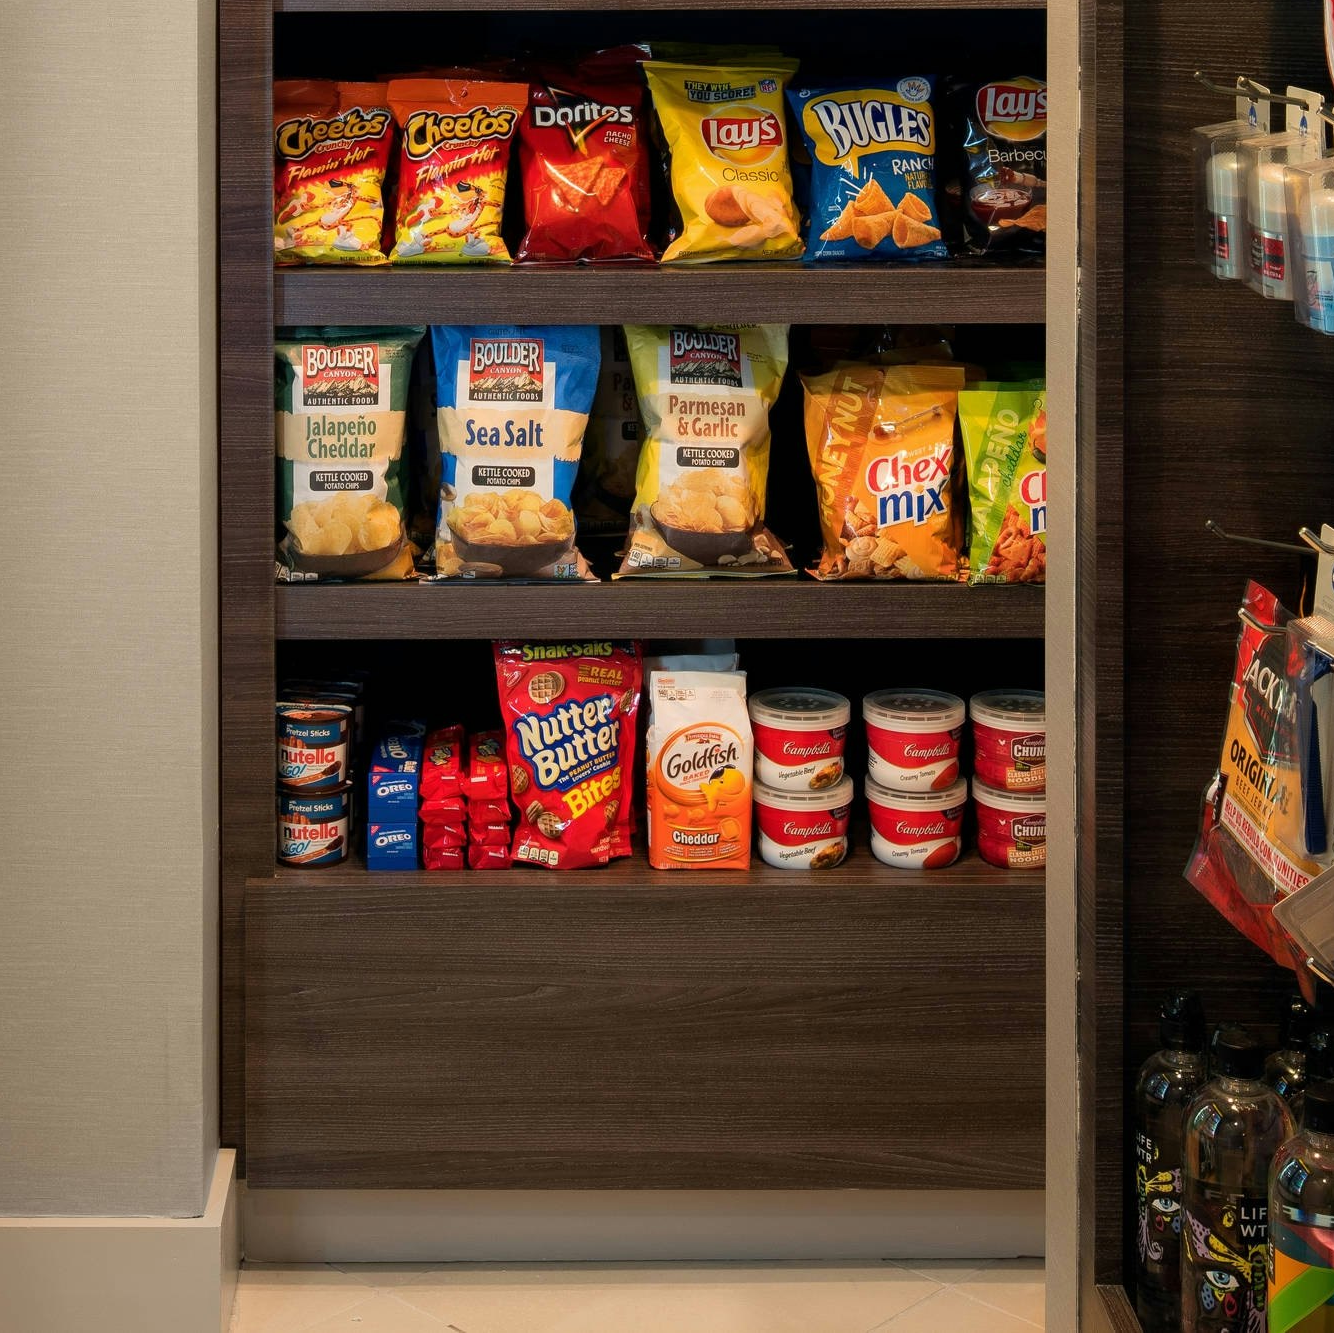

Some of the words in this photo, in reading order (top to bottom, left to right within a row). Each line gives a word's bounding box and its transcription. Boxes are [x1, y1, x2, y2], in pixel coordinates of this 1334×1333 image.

[685, 80, 709, 92] THEY
[689, 88, 711, 101] YOU
[713, 86, 756, 101] SCORE!
[534, 101, 634, 127] Doritos
[278, 109, 387, 156] Cheetos
[406, 109, 513, 156] Cheetos
[605, 129, 633, 141] NACHO
[709, 115, 778, 151] Lay's
[812, 99, 931, 159] BUGLES
[315, 139, 354, 154] Crunchy
[442, 139, 481, 151] Crunchy
[603, 135, 632, 148] CHEESE
[470, 146, 500, 169] Hot
[288, 158, 341, 187] Flamin'
[343, 146, 375, 166] Hot
[722, 167, 779, 182] Classic
[672, 329, 739, 362] BOULDER
[305, 346, 377, 377] BOULDER
[473, 341, 541, 373] BOULDER
[690, 352, 723, 361] CANYON
[323, 370, 358, 379] CANYON
[490, 365, 523, 375] CANYON
[674, 377, 716, 386] AUTHENTIC
[717, 378, 740, 388] FOODS
[307, 396, 350, 406] AUTHENTIC
[351, 397, 376, 406] FOODS
[473, 392, 514, 401] AUTHENTIC
[515, 392, 540, 402] FOODS
[831, 376, 869, 432] NUT
[669, 394, 746, 417] Parmesan
[306, 415, 378, 442] Jalapeño
[465, 418, 501, 447] Sea
[505, 419, 544, 448] Salt
[677, 416, 689, 436] &
[691, 417, 739, 438] Garlic
[307, 438, 377, 459] Cheddar
[682, 448, 706, 458] KETTLE
[706, 449, 735, 459] COOKED
[691, 458, 711, 467] POTATO
[711, 459, 726, 467] CHIPS
[868, 447, 952, 493] Chex
[315, 472, 339, 482] KETTLE
[340, 472, 369, 482] COOKED
[478, 468, 502, 478] KETTLE
[502, 469, 531, 478] COOKED
[324, 482, 344, 491] POTATO
[345, 482, 360, 491] CHIPS
[486, 477, 506, 486] POTATO
[506, 477, 521, 486] CHIPS
[879, 486, 945, 526] mix
[590, 666, 623, 680] REAL
[1242, 658, 1279, 703] JACK
[577, 676, 600, 685] peanut
[600, 677, 622, 686] butter
[285, 727, 309, 737] Pretzel
[309, 728, 331, 738] Sticks
[517, 697, 612, 757] Nutter
[281, 748, 336, 765] nutella
[532, 719, 620, 786] Butter
[667, 742, 738, 778] Goldfish
[557, 775, 570, 785] The
[569, 761, 594, 777] PEANUT
[593, 751, 616, 765] BUTTER
[572, 767, 592, 782] Lovers'
[592, 760, 612, 772] Cookie
[682, 769, 710, 782] BAKED
[778, 769, 804, 781] Vegetable
[803, 766, 817, 776] Beef
[900, 772, 919, 782] Creamy
[919, 769, 936, 778] Tomato
[376, 783, 413, 797] OREO
[562, 767, 621, 820] Bites
[1235, 774, 1251, 798] BEEF
[1250, 792, 1275, 820] JERKY
[288, 803, 312, 813] Pretzel
[313, 802, 334, 813] Sticks
[1224, 797, 1237, 818] HELP
[1235, 812, 1243, 826] US
[1240, 818, 1261, 849] REBUILD
[283, 823, 339, 840] nutella
[672, 830, 720, 845] Cheddar
[375, 833, 412, 847] OREO
[779, 849, 804, 860] Vegetable
[804, 846, 817, 855] Beef
[891, 849, 909, 858] Creamy
[910, 846, 929, 855] Tomato
[1240, 1206, 1267, 1221] LIF
